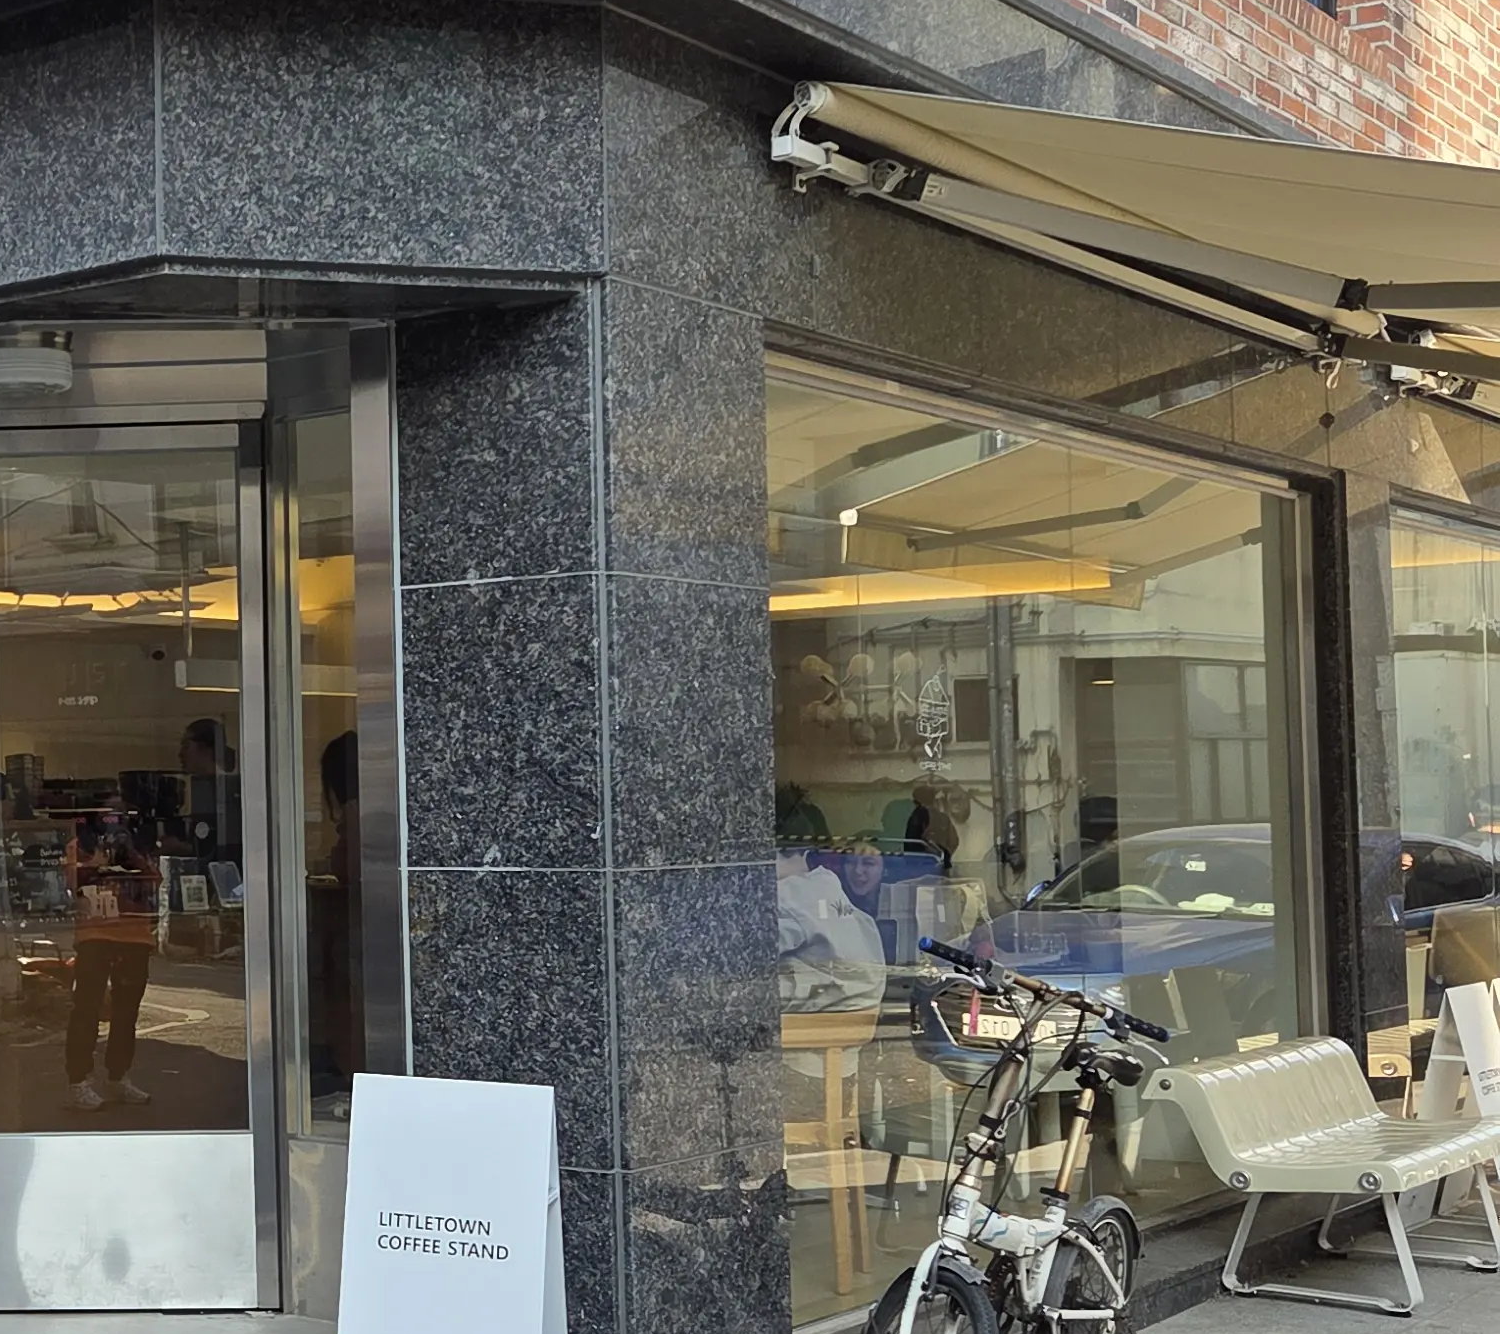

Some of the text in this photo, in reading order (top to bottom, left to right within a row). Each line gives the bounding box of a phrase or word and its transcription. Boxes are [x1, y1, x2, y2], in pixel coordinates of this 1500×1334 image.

[379, 1211, 491, 1236] LITTLETOWN
[377, 1234, 509, 1260] COFFEE STAND
